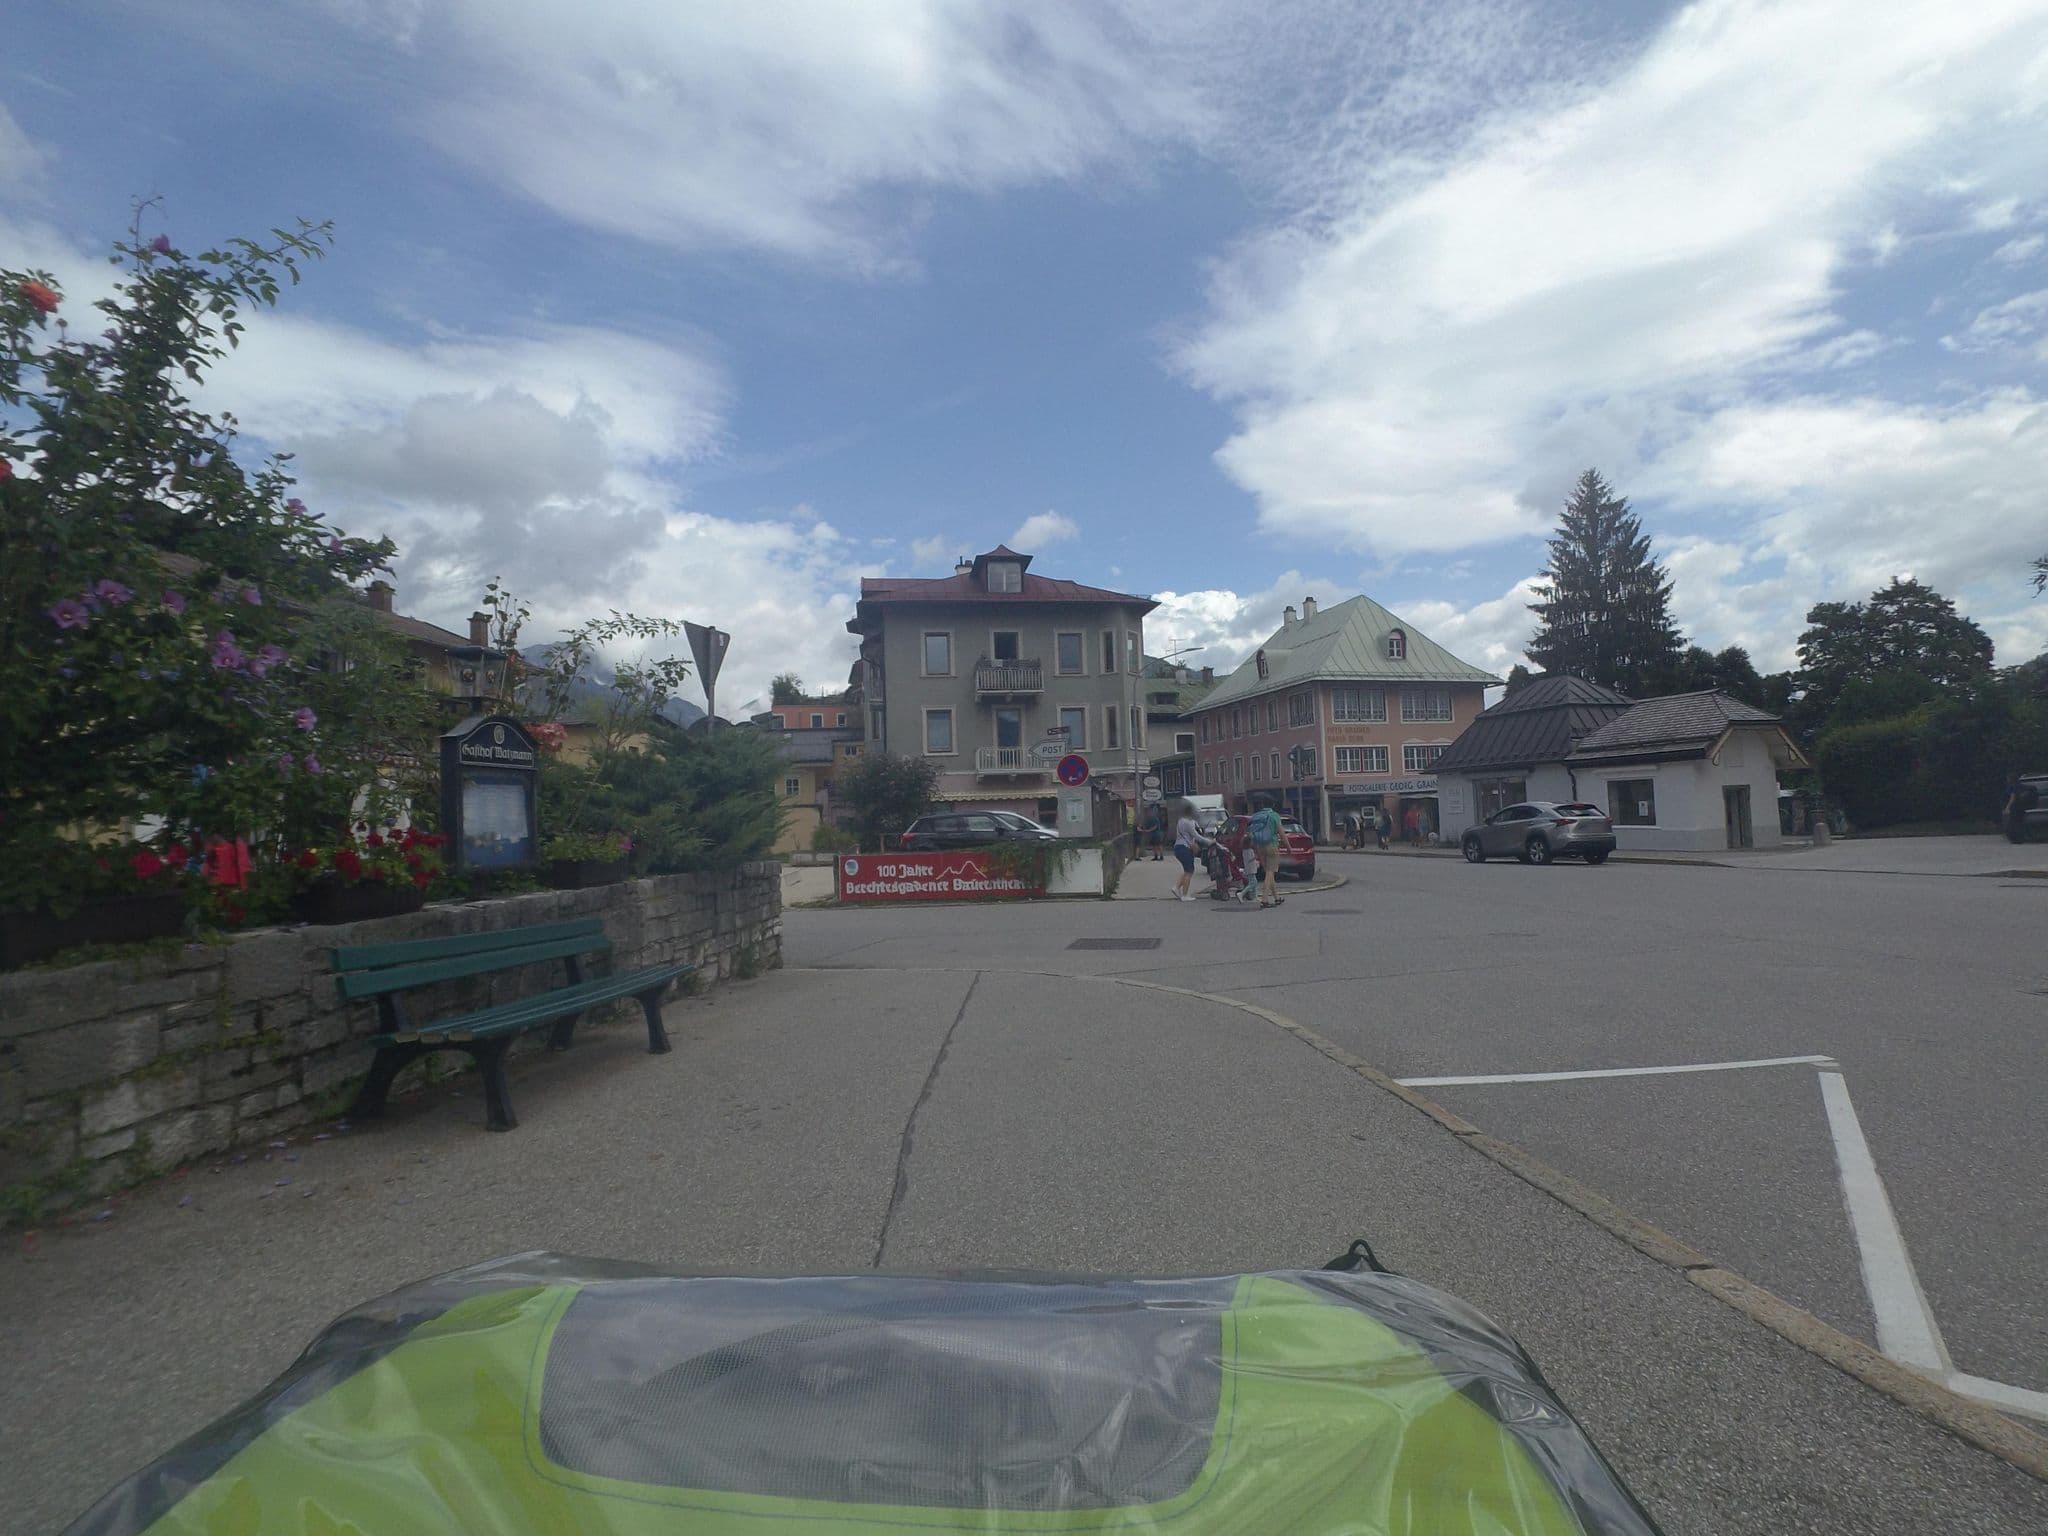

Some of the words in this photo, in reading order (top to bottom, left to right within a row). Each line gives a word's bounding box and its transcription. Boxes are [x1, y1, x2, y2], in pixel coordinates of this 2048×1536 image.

[461, 744, 493, 759] Gasthof
[1042, 744, 1063, 754] POST
[1389, 780, 1413, 791] GEORG
[876, 864, 896, 878] 100
[898, 863, 934, 879] Jahre
